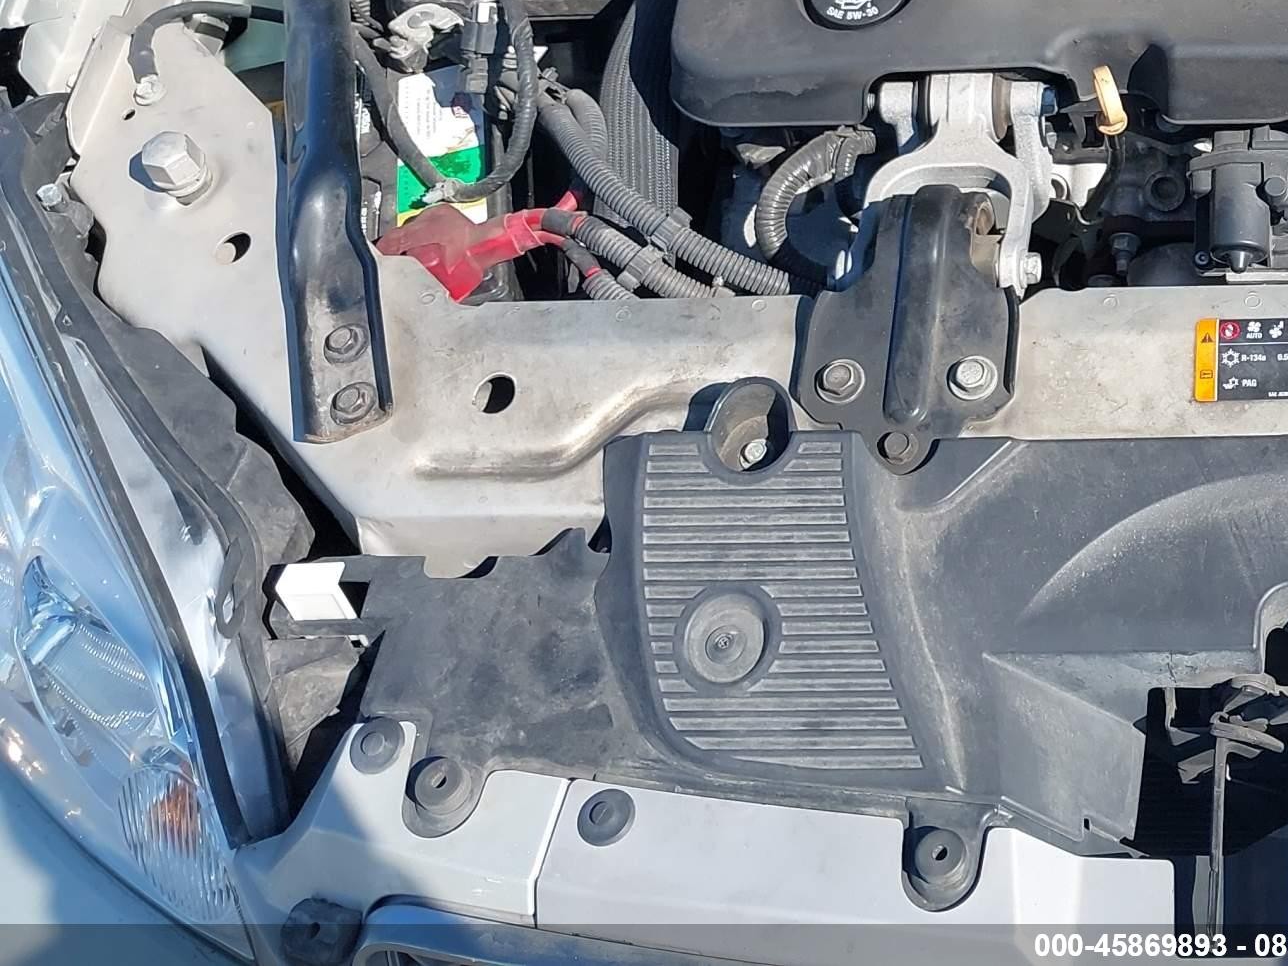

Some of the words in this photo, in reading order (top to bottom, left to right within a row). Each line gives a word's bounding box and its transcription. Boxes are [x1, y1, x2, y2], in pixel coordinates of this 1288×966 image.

[826, 6, 844, 20] SAE
[847, 6, 880, 21] 5W-30
[1241, 354, 1267, 362] R-134a
[1241, 378, 1258, 387] PAG
